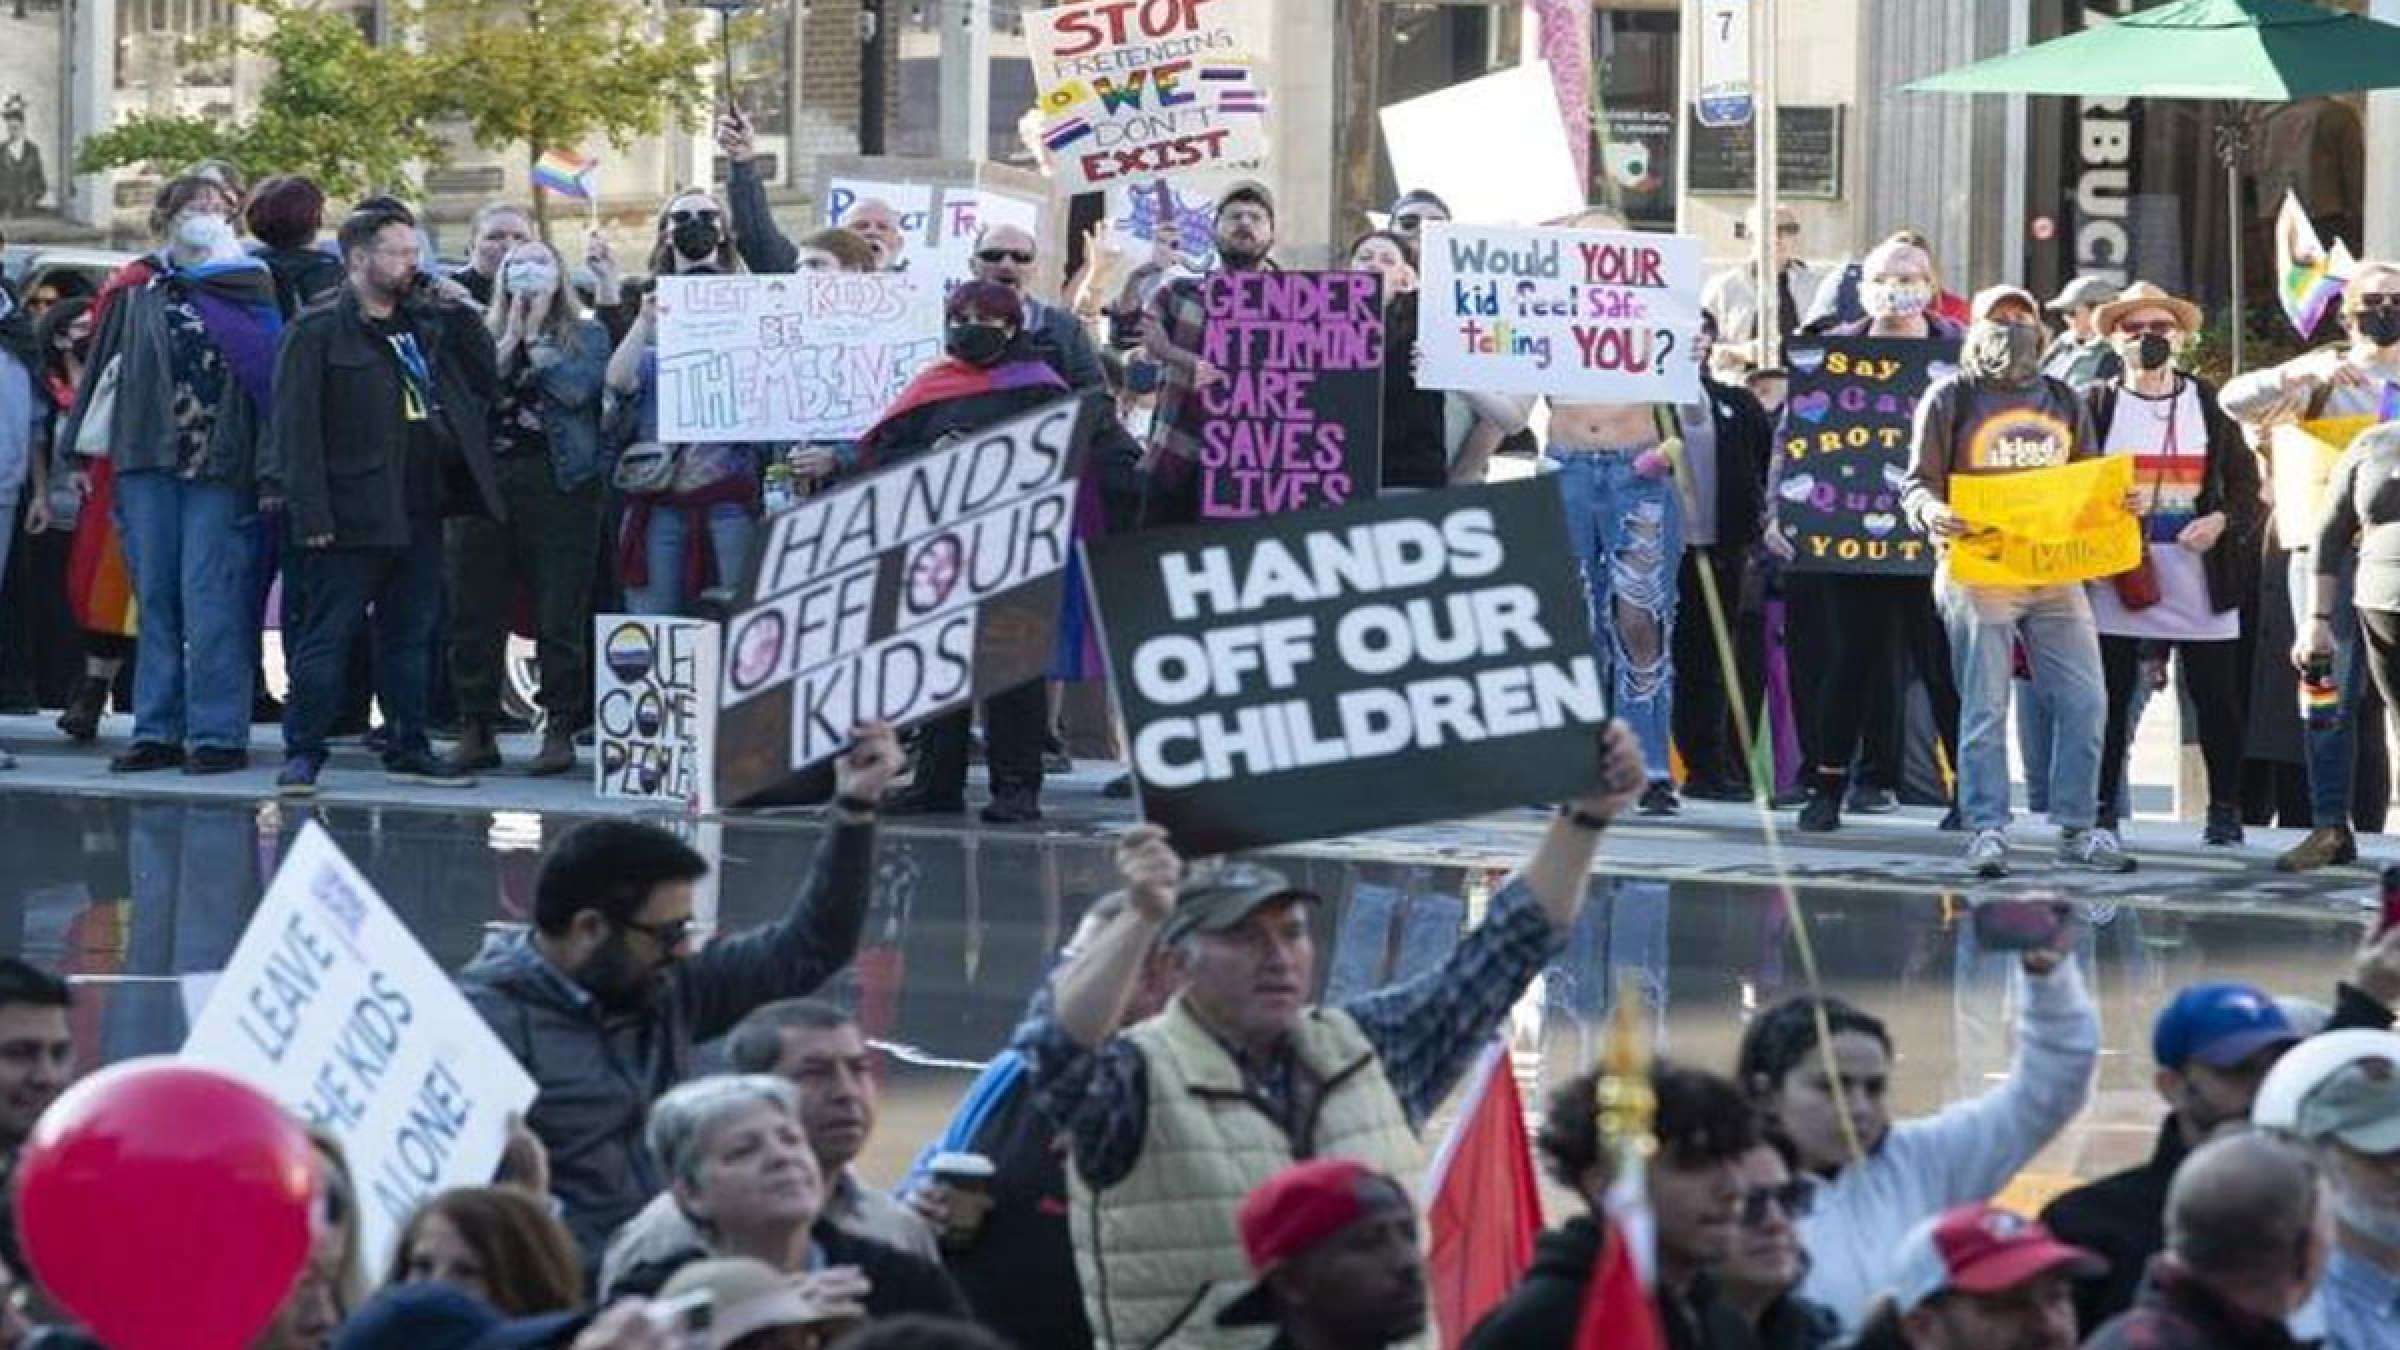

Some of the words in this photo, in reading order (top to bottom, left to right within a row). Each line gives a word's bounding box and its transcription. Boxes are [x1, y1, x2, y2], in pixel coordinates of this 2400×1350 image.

[1092, 60, 1195, 114] WE
[1081, 129, 1230, 182] EXIST
[1450, 238, 1558, 278] Would
[1578, 241, 1662, 286] YOUR
[685, 280, 753, 313] LET
[808, 274, 906, 322] KIDS
[1205, 272, 1377, 321] GENDER
[1455, 279, 1499, 316] kid
[760, 314, 803, 349] BE
[1203, 319, 1383, 369] AFFIRMING
[1459, 320, 1551, 370] telling
[1572, 325, 1675, 376] YOU?
[1826, 352, 1902, 382] Say
[1201, 370, 1316, 418] CARE
[1200, 420, 1346, 471] SAVES
[770, 411, 1068, 590] HANDS
[1203, 470, 1351, 516] LIVES
[1159, 507, 1504, 620] HANDS
[731, 568, 874, 692] OFF
[908, 495, 1067, 615] OUR
[1132, 616, 1316, 704] OFF
[1336, 584, 1552, 675] OUR
[803, 617, 971, 759] KIDS
[1134, 654, 1606, 788] CHILDREN
[238, 911, 335, 1063] LEAVE
[334, 970, 414, 1091] KIDS
